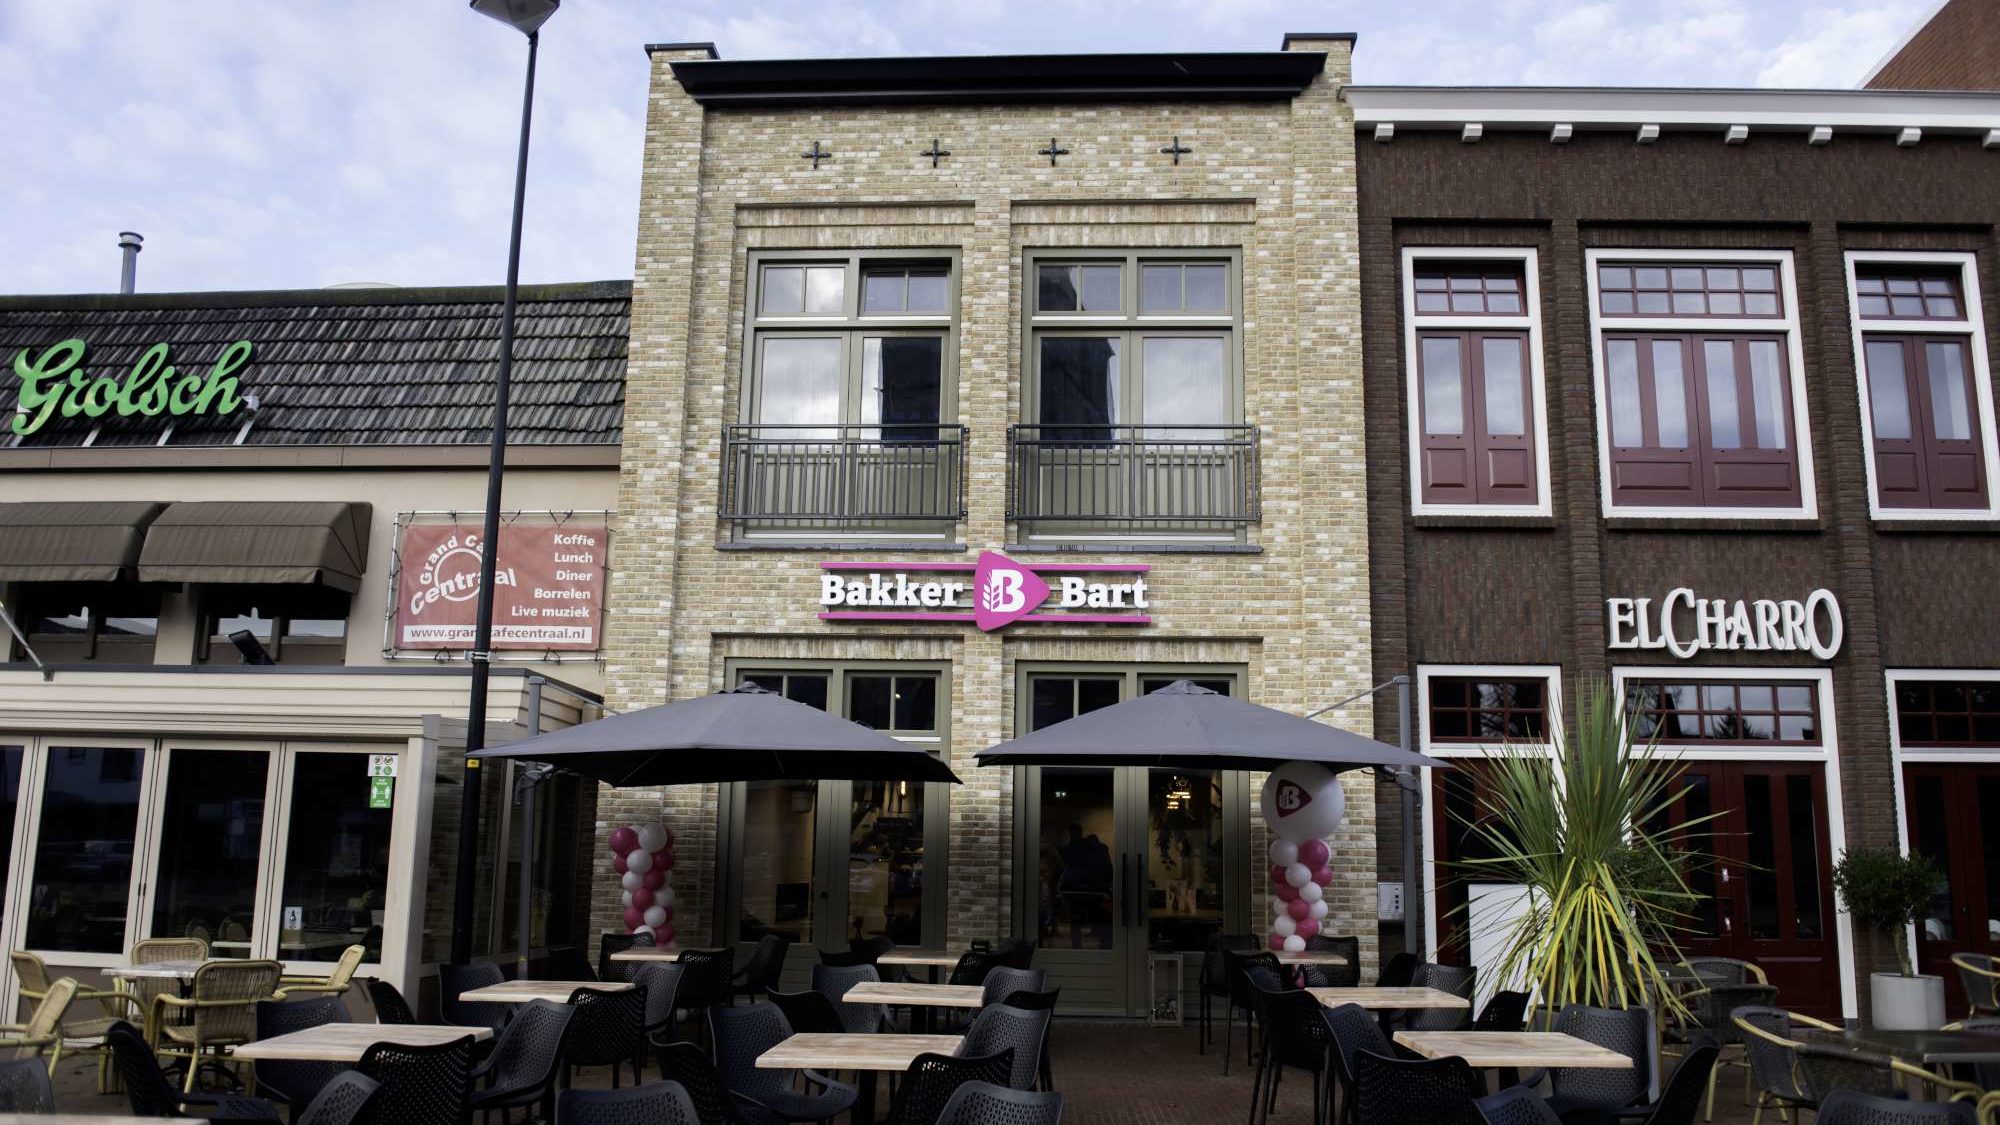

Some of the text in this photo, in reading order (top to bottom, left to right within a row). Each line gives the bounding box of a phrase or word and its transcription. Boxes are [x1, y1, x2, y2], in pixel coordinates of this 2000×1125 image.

[11, 338, 253, 435] Grolsch
[553, 534, 595, 547] Koffie
[419, 535, 458, 585] Grand
[554, 552, 593, 563] Lunch
[556, 570, 593, 581] Diner
[411, 567, 517, 615] Central
[534, 588, 591, 599] Borrelen
[820, 573, 964, 607] Bakker
[1060, 576, 1149, 609] Bart
[511, 605, 590, 618] Live muziek
[411, 627, 585, 640] www.granafecentraal.nl
